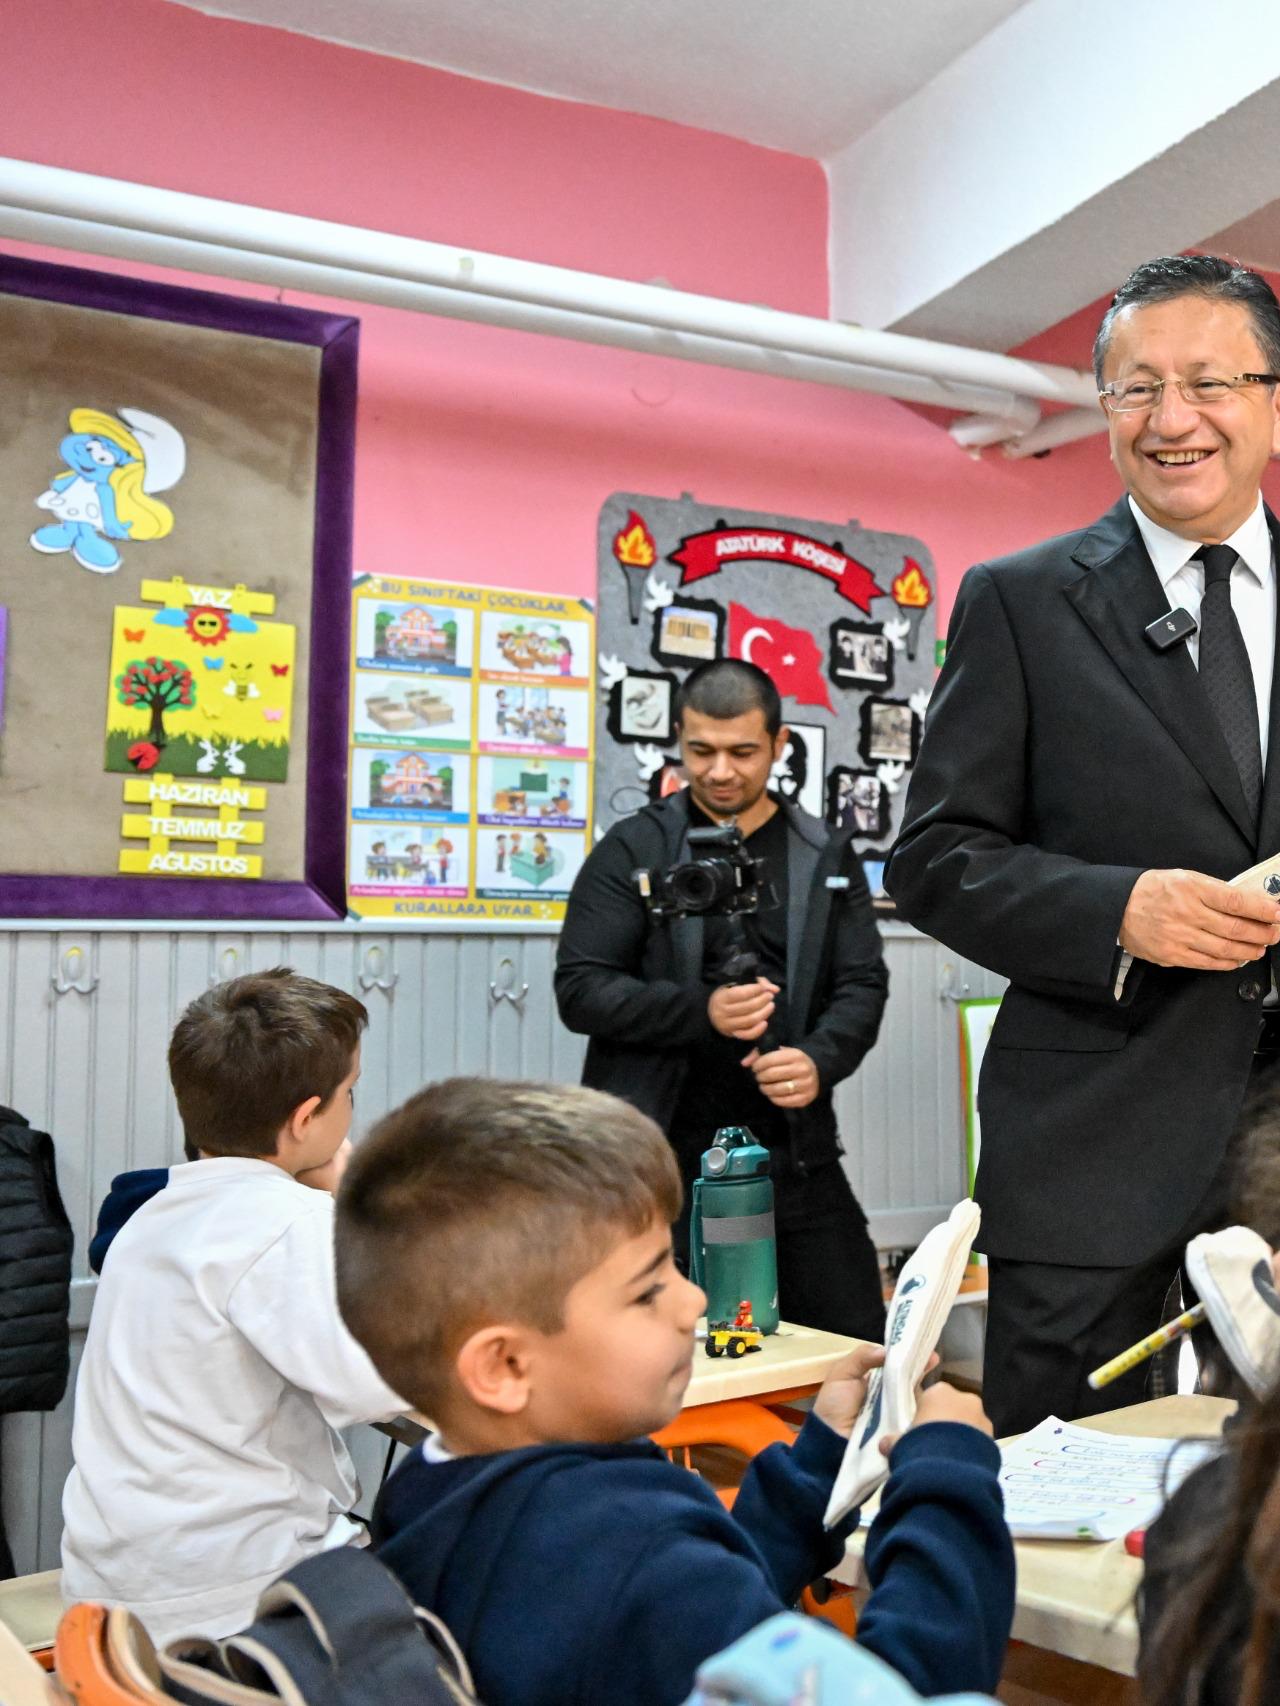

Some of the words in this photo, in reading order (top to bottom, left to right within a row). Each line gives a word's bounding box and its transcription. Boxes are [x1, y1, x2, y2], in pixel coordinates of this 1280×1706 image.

[716, 535, 786, 556] ATATÜRK
[188, 585, 233, 609] YAZ
[381, 582, 401, 594] BU
[488, 594, 567, 613] ÇOCUKLAR
[148, 817, 246, 839] TEMMUZ
[394, 902, 486, 914] KURALLARA
[493, 903, 533, 915] UYAR
